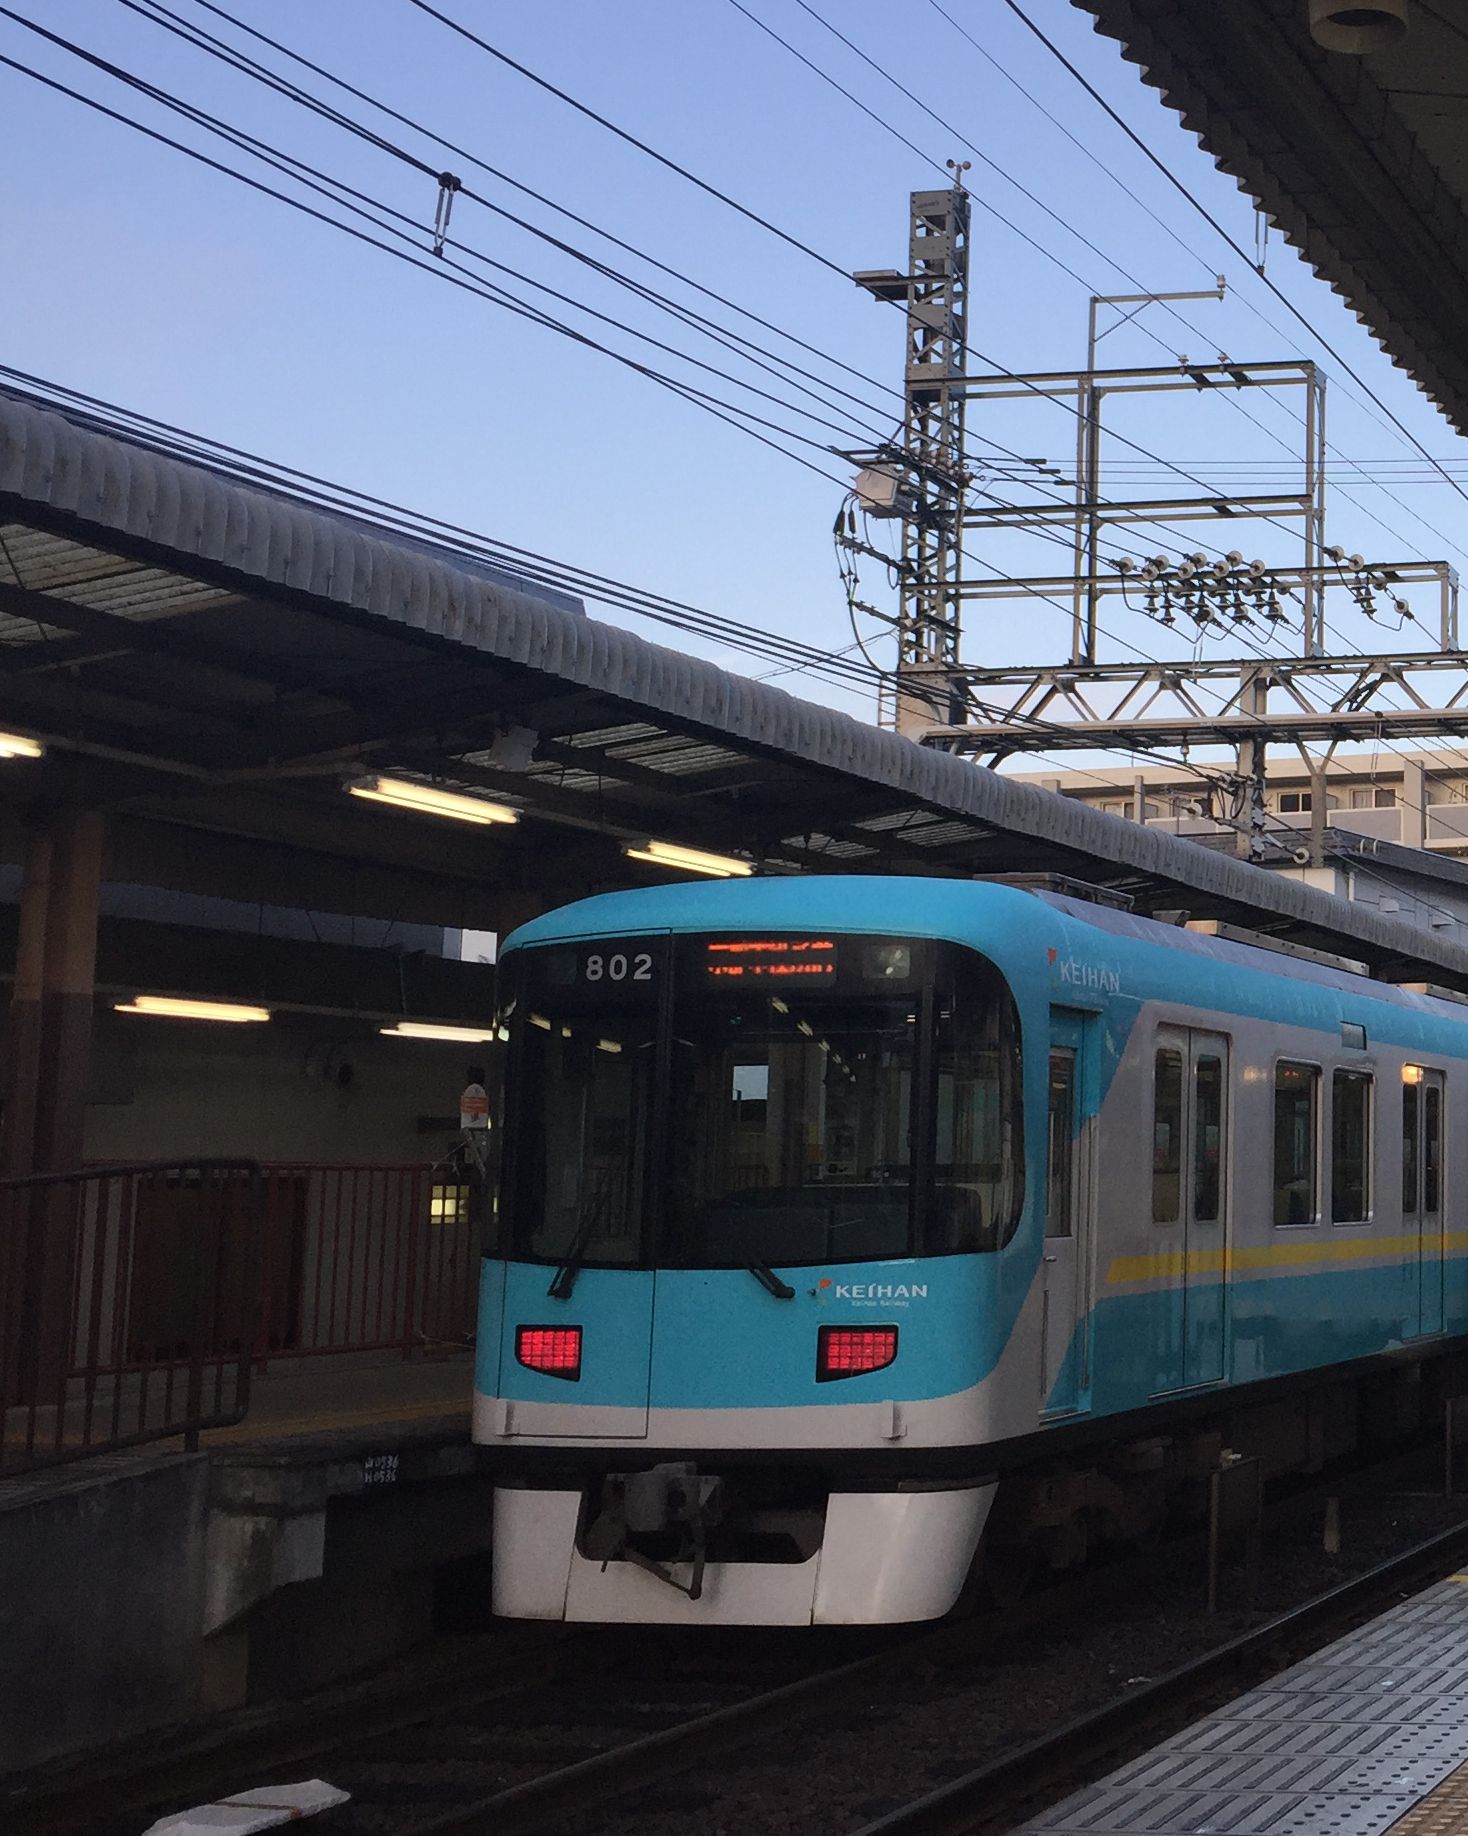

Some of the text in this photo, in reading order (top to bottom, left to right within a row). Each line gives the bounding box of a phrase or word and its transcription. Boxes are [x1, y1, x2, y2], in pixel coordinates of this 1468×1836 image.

[585, 953, 652, 982] 802
[1060, 960, 1120, 993] KEIHAN
[835, 1283, 928, 1298] KEIHAN
